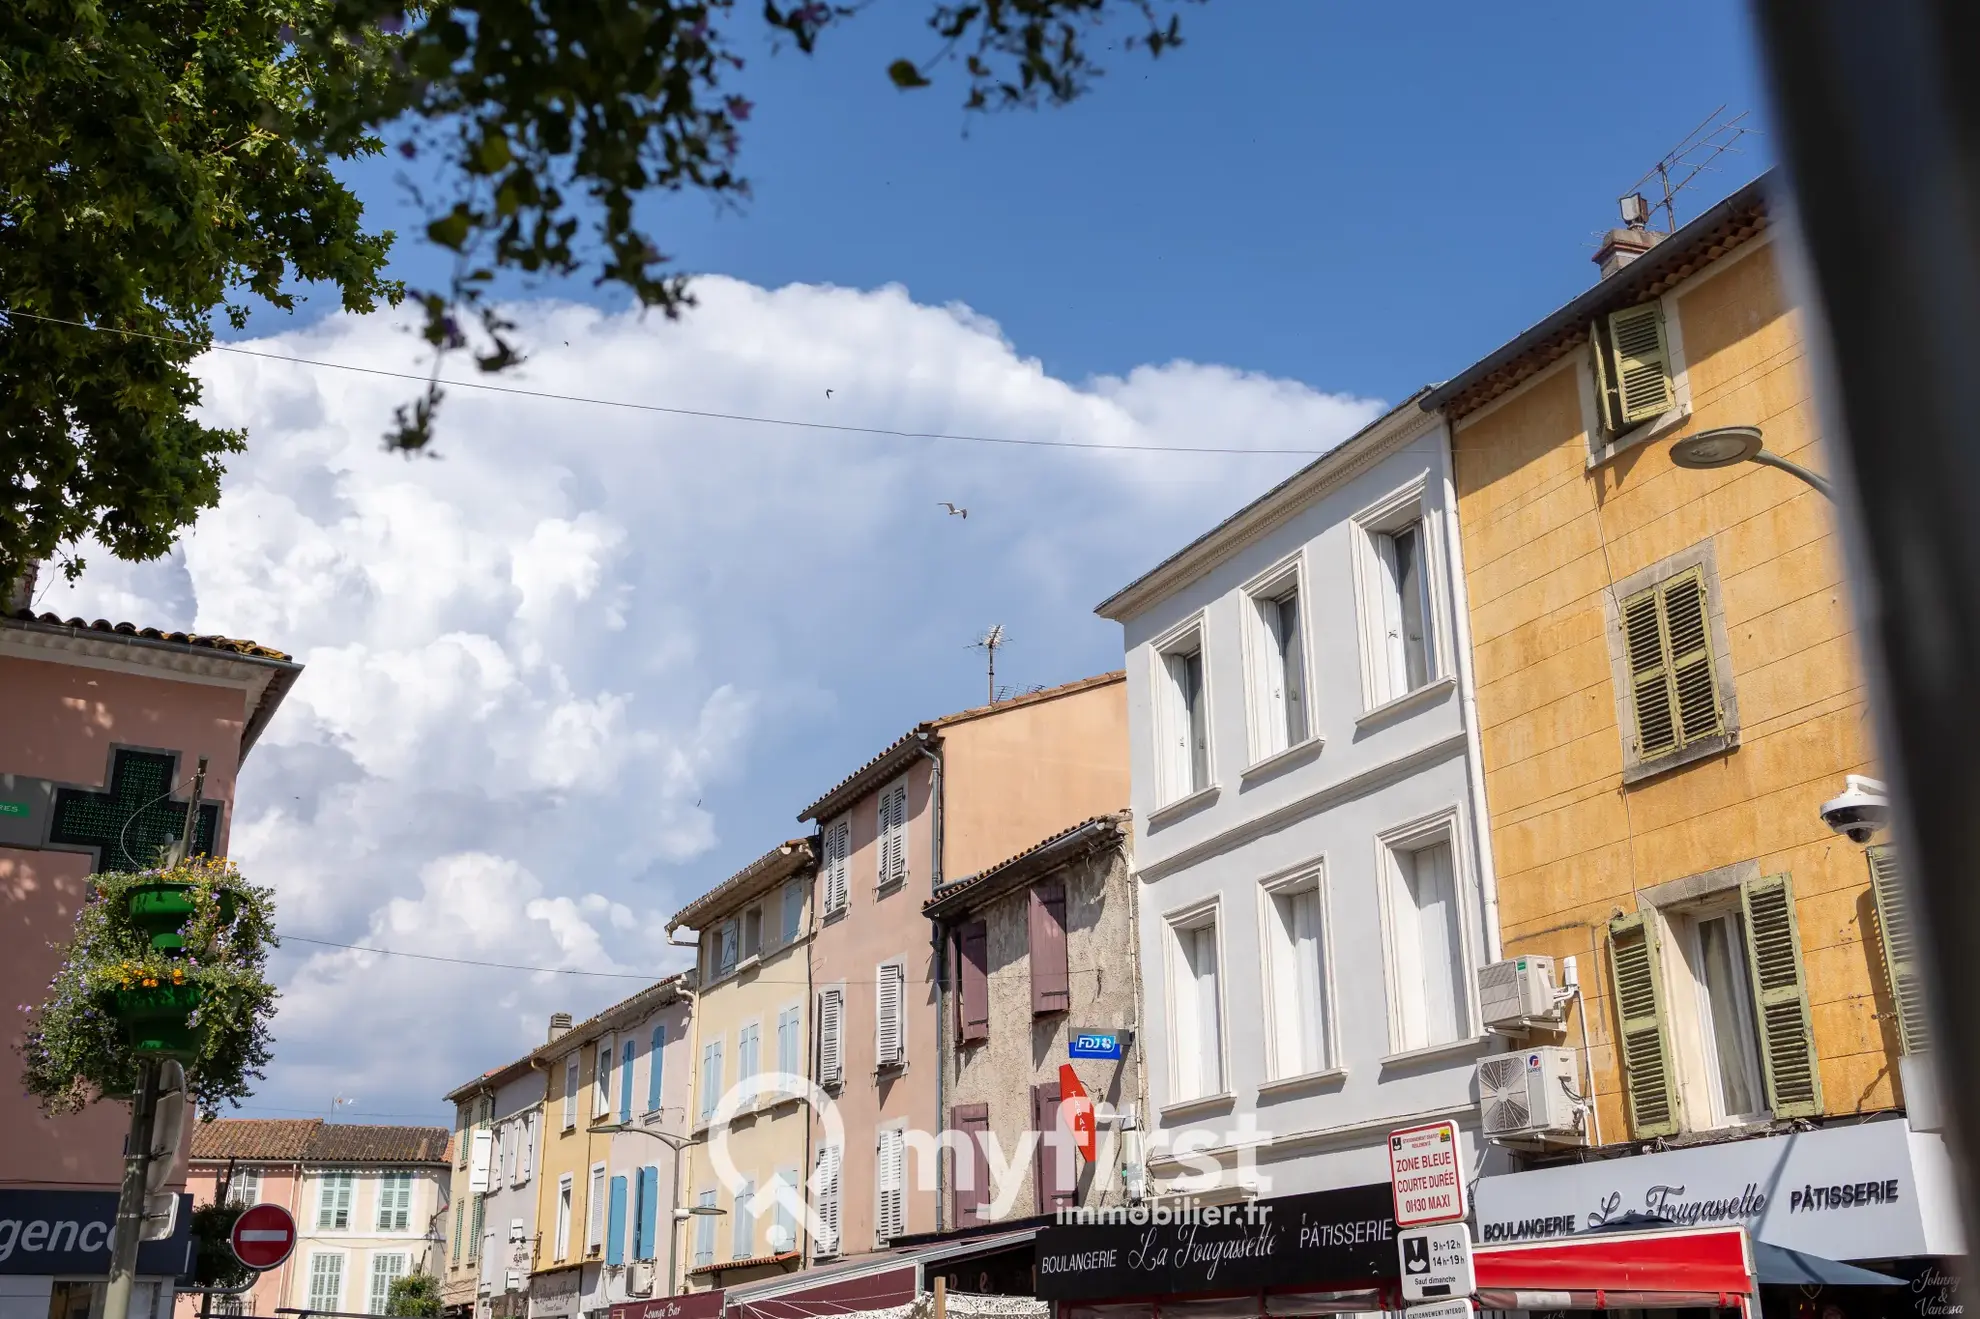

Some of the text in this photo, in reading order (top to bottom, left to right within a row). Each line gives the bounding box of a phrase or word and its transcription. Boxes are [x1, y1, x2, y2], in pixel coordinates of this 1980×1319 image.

[1078, 1037, 1101, 1049] FDJ
[1070, 1090, 1087, 1134] TABAC
[1396, 1152, 1452, 1173] ZONE BLEUE
[1397, 1169, 1455, 1194] COURTE DURÉE
[1405, 1194, 1451, 1213] 0H30 MAXI
[1483, 1214, 1576, 1242] BOULANGERIE
[1646, 1183, 1766, 1226] Fougassette
[1790, 1179, 1899, 1213] PÂTISSERIE
[1041, 1218, 1393, 1281] BOULANGERIE La Fougassette PÂTISSERIE
[1414, 1275, 1456, 1286] Sauf dimanche
[1911, 1267, 1962, 1294] Johnny
[1914, 1294, 1965, 1317] Vanessa
[1938, 1288, 1948, 1303] &
[643, 1302, 682, 1319] Lounge Bar
[1445, 1306, 1466, 1316] INTERDIT
